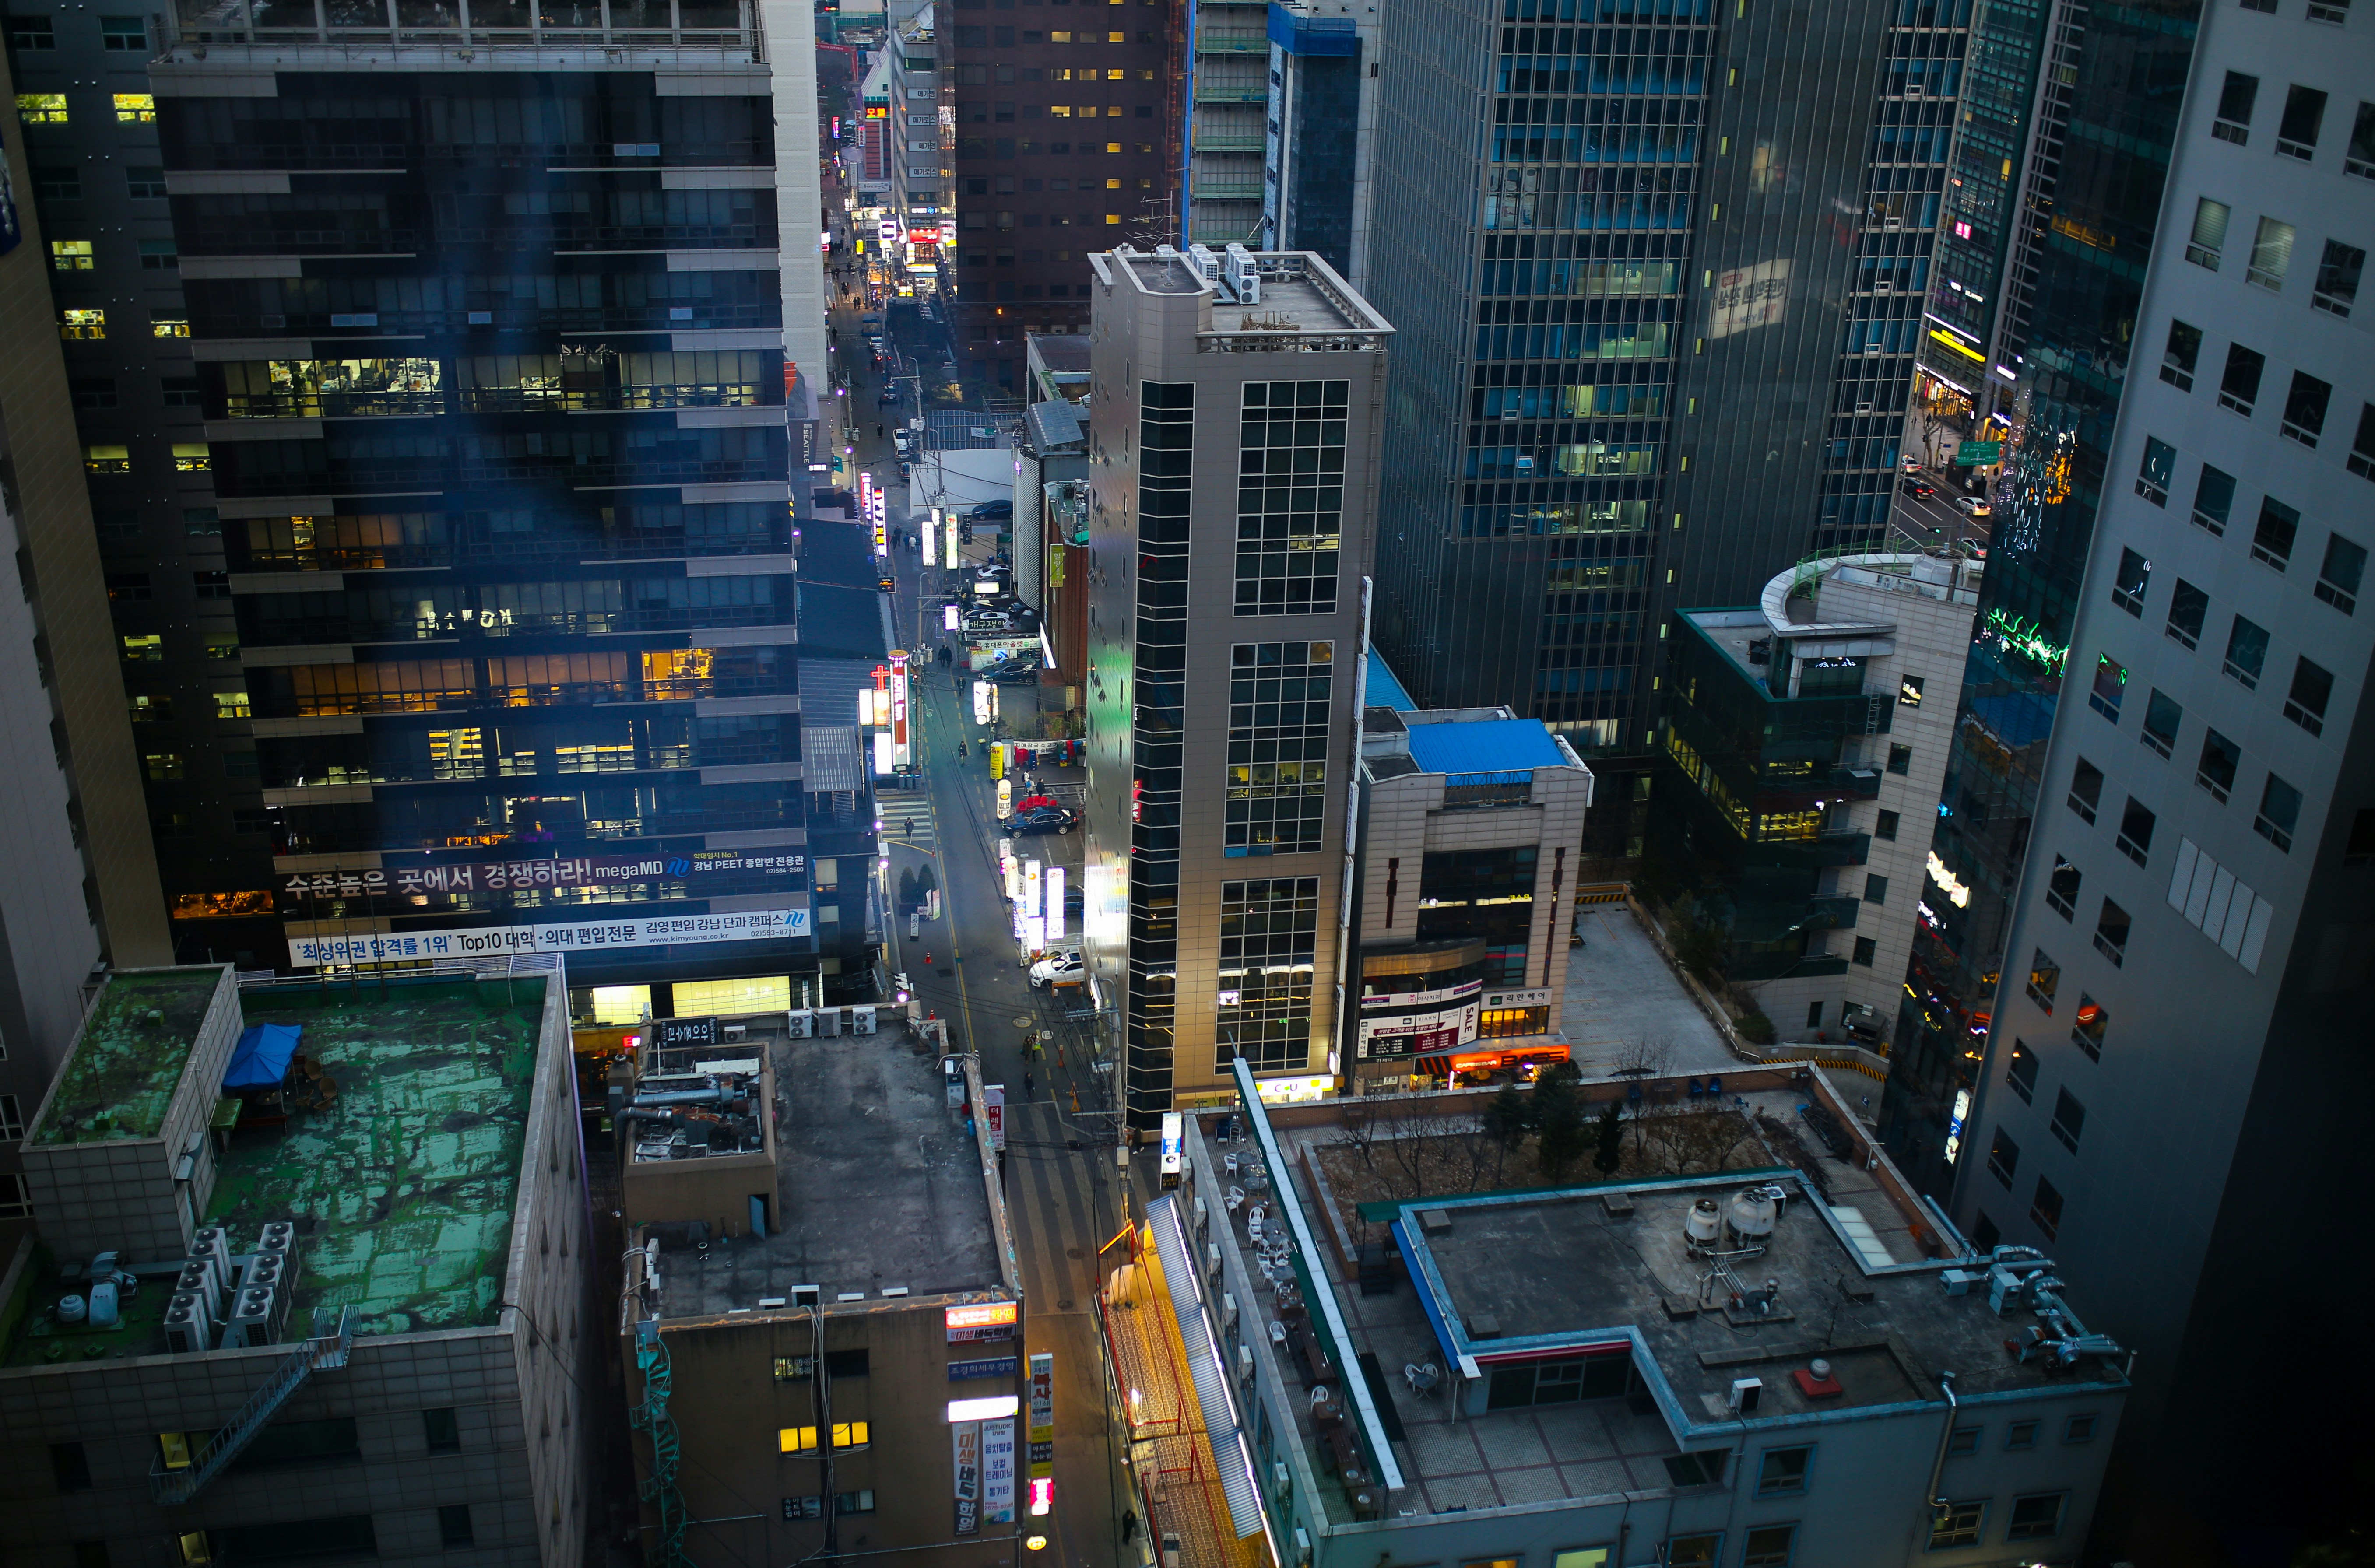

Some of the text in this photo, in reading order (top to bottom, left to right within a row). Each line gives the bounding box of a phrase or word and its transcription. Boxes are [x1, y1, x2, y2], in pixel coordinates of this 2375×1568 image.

[694, 856, 804, 871] 강남 PEET 종합반 전용관
[766, 866, 804, 875] 02)584-2500
[285, 859, 663, 900] 수준높은 곳에서 경쟁하라! megaMD
[697, 918, 720, 931] 강남
[723, 916, 746, 929] 단과
[749, 914, 784, 927] 캠퍼스
[649, 932, 729, 943] www.kimyoung.co.kr
[370, 936, 418, 957] 합격률
[457, 932, 502, 952] Top10
[1506, 992, 1545, 1002] 리안헤어
[1464, 1007, 1474, 1033] SALE
[668, 1024, 708, 1042] 아이폰수리
[1501, 1051, 1565, 1067] BASS
[1274, 1084, 1298, 1092] CU
[986, 1442, 1012, 1454] 음치탈출
[993, 1458, 1006, 1469] 보컬
[986, 1467, 1013, 1480] 트레이닝
[989, 1484, 1010, 1497] 통기타
